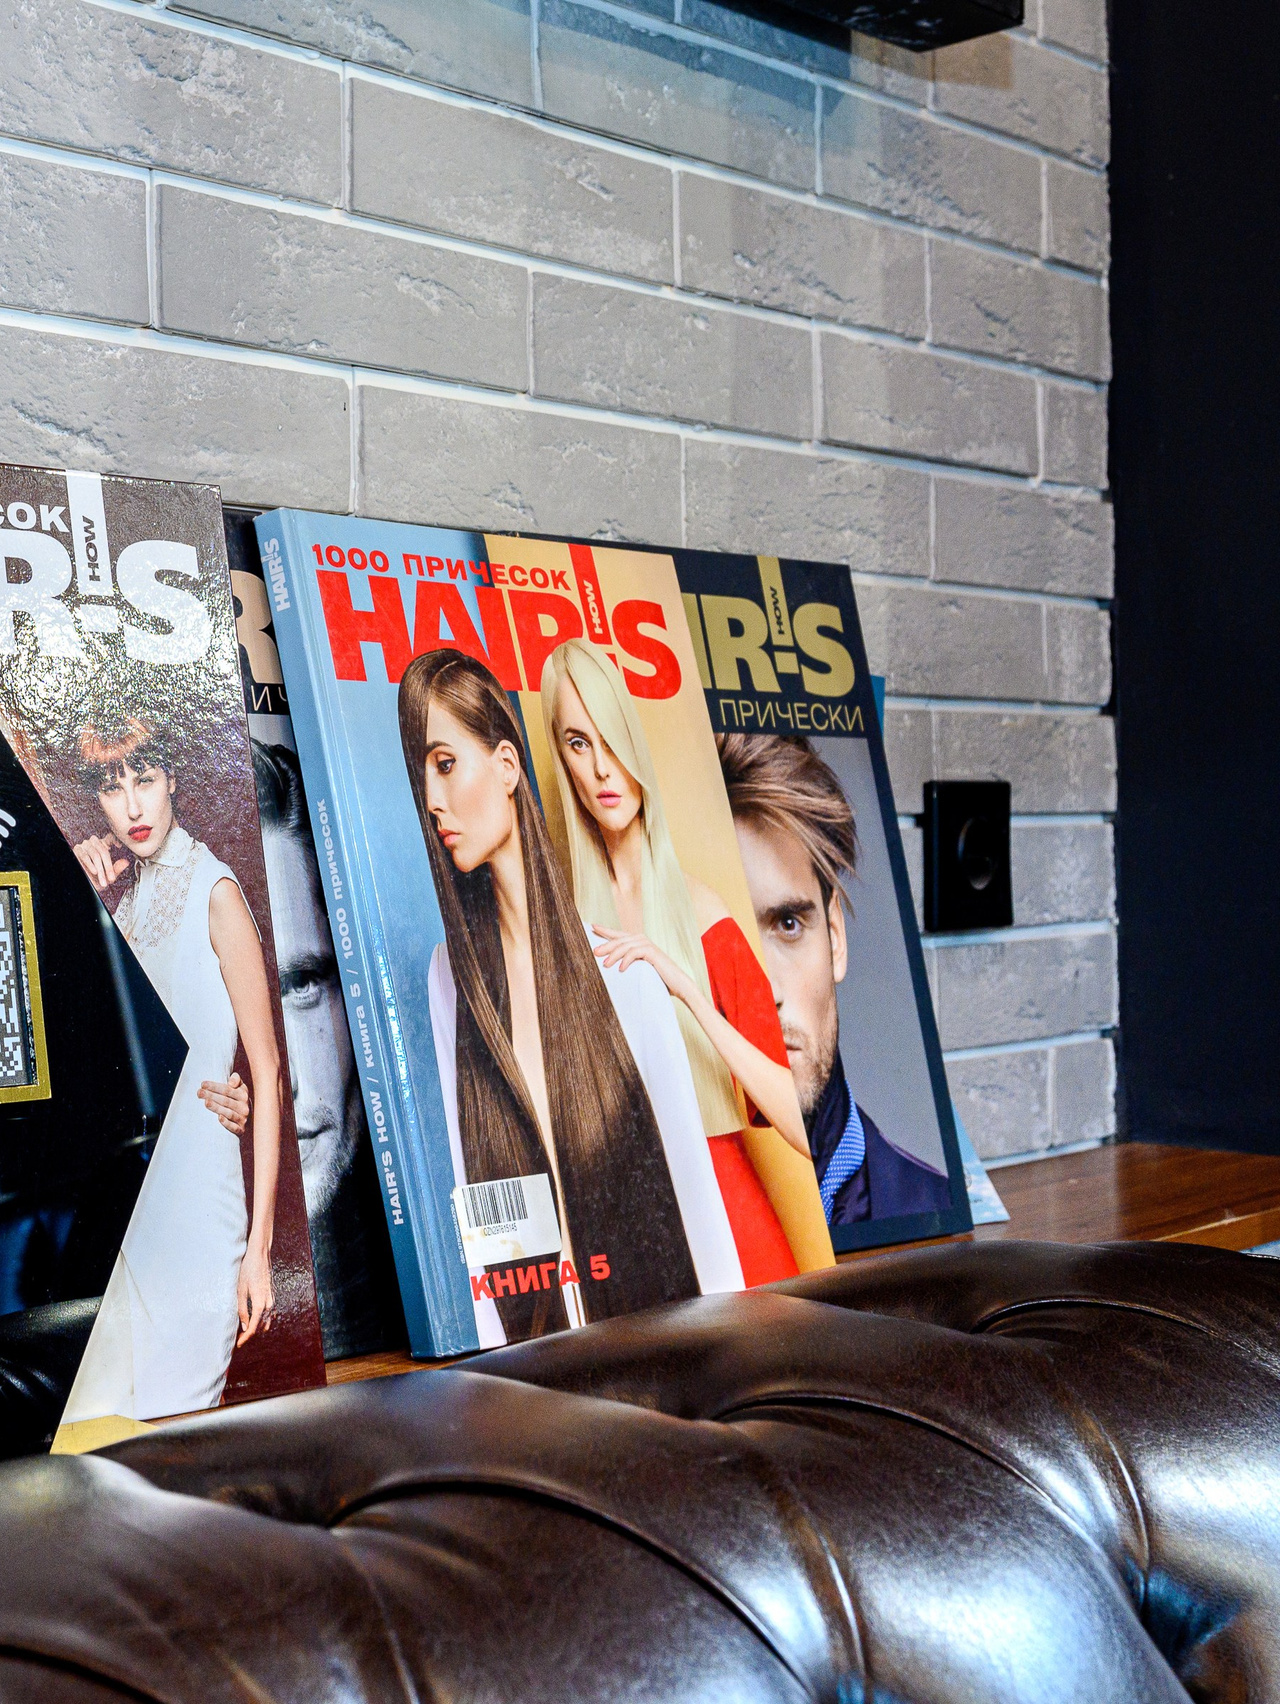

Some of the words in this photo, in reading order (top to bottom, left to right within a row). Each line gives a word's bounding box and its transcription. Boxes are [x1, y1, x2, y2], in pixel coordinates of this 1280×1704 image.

[82, 515, 101, 582] HOW
[312, 543, 389, 573] 1000
[402, 553, 572, 591] ПРИЧЕСОК
[583, 580, 603, 634] HOW
[769, 586, 785, 635] HOW
[719, 699, 865, 732] ПРИЧЕСКИ
[336, 907, 354, 959] 1000
[350, 983, 361, 998] 5
[370, 1091, 389, 1143] HOW
[381, 1151, 404, 1225] HAIR'S
[470, 1259, 580, 1301] КНИГА
[590, 1253, 610, 1280] 5
